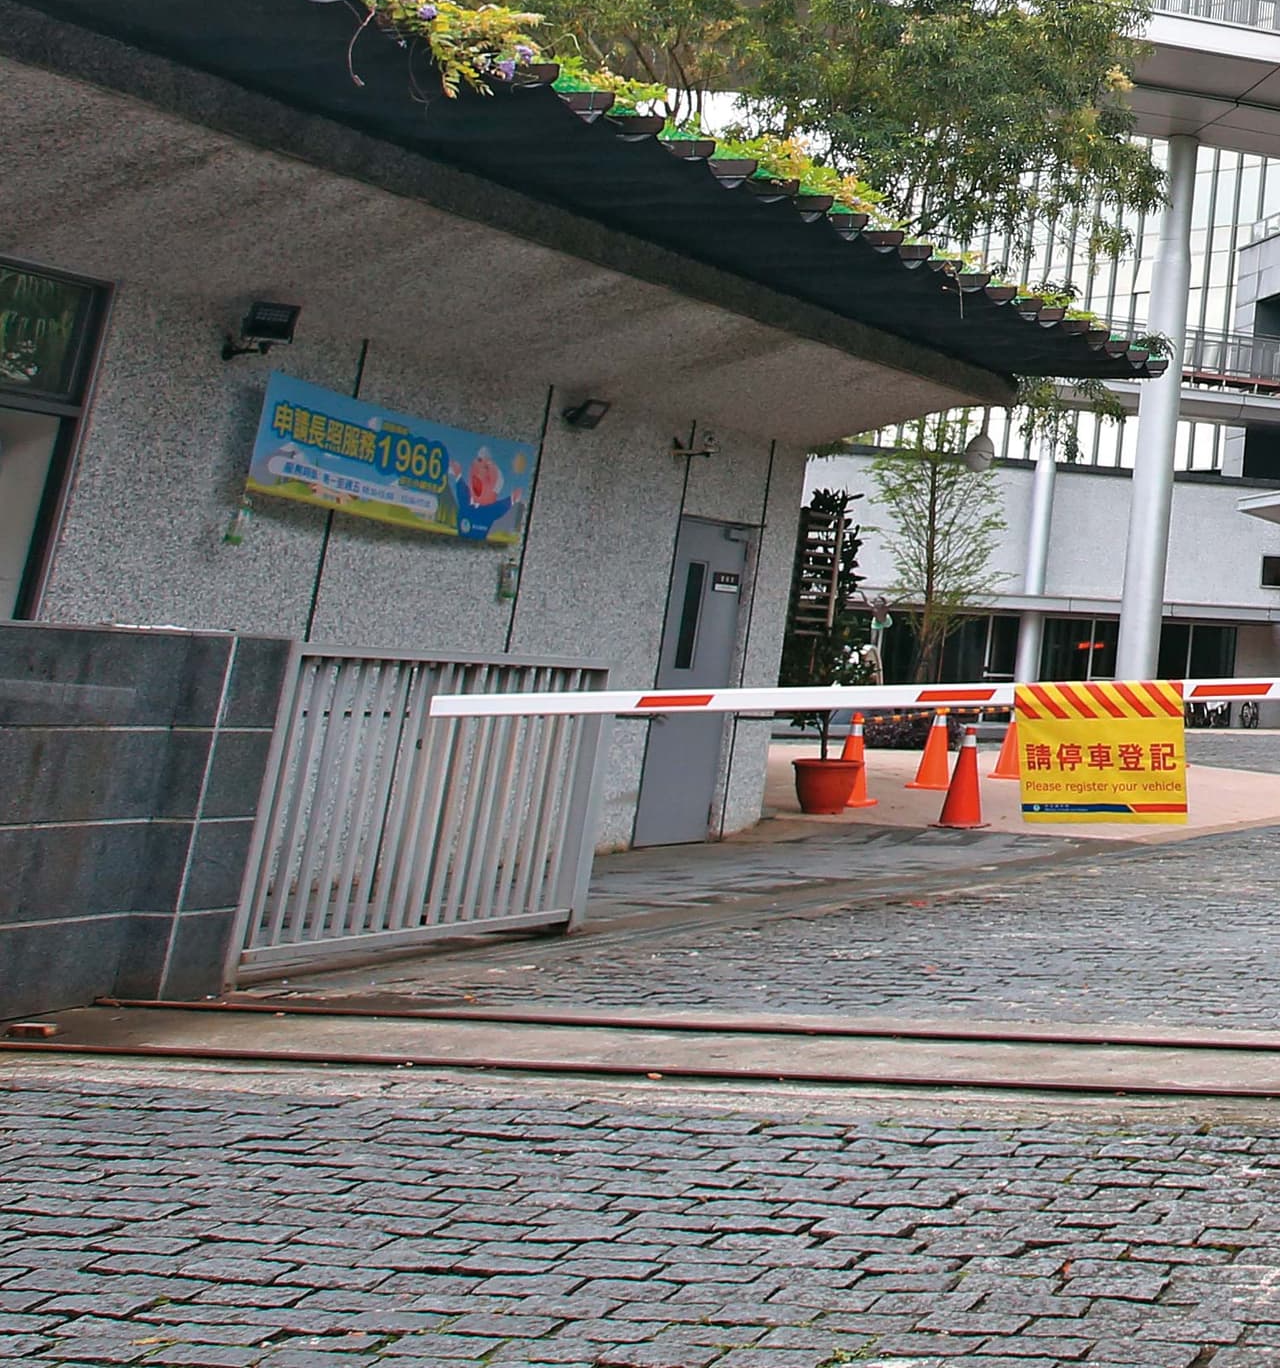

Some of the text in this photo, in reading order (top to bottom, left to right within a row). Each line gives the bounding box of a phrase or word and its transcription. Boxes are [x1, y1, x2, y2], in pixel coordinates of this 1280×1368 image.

[378, 435, 443, 480] 1966
[1025, 743, 1177, 771] 請停車登記
[1026, 781, 1182, 794] Please register your vehicle
